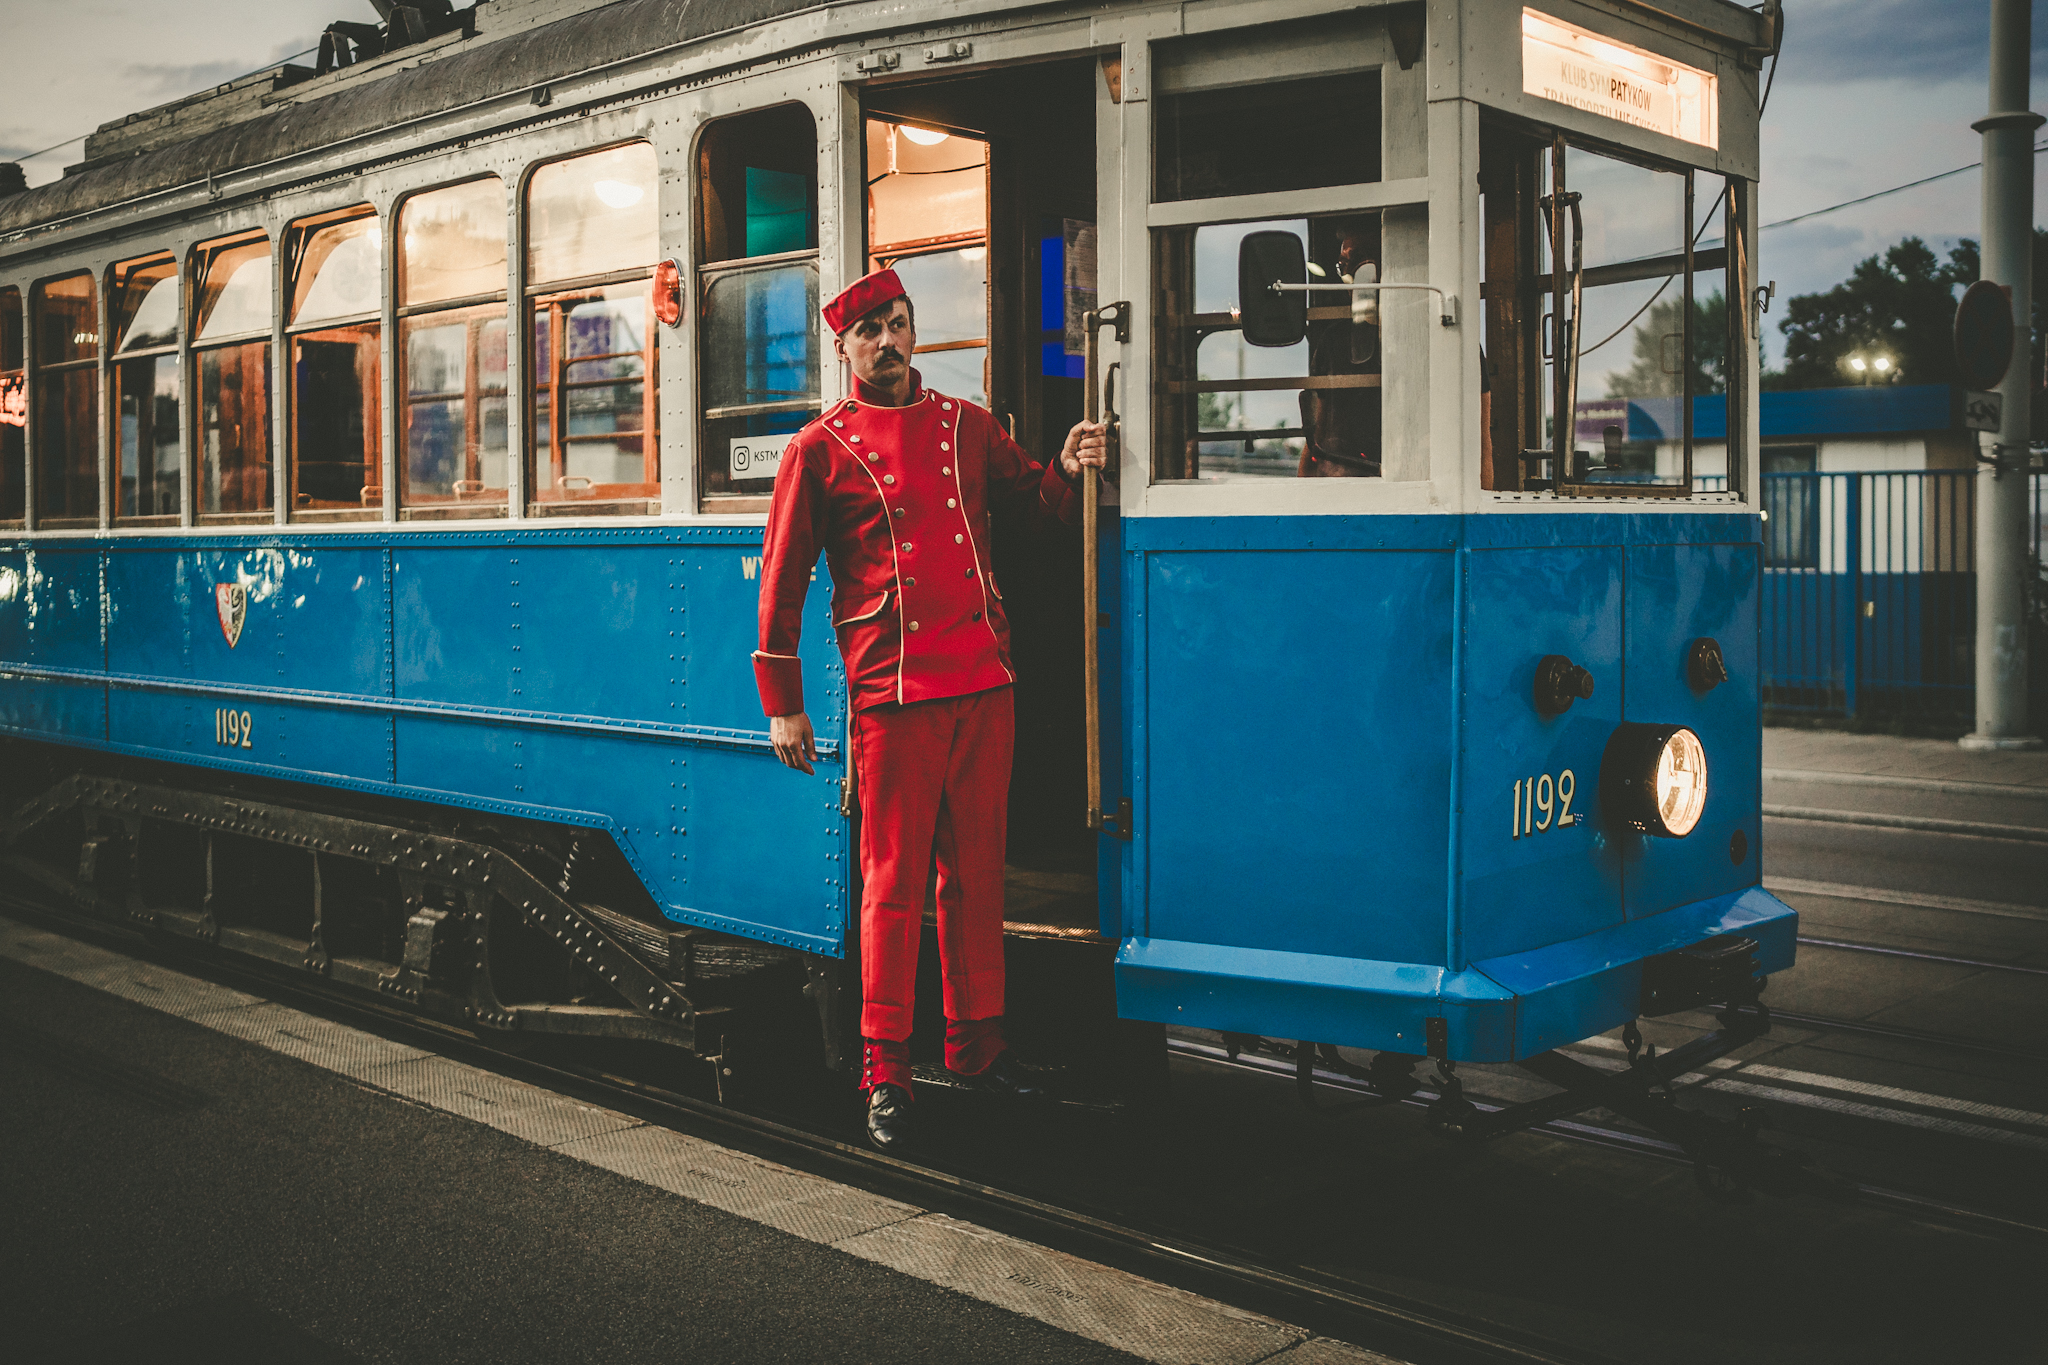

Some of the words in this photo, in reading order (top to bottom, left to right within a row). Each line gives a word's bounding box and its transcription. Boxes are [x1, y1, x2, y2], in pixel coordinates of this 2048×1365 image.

[1561, 61, 1588, 90] KLUB
[1589, 72, 1652, 112] SYMPATYKÓW
[754, 449, 784, 463] KSTM_
[215, 707, 253, 748] 1192
[1512, 768, 1576, 841] 1192
